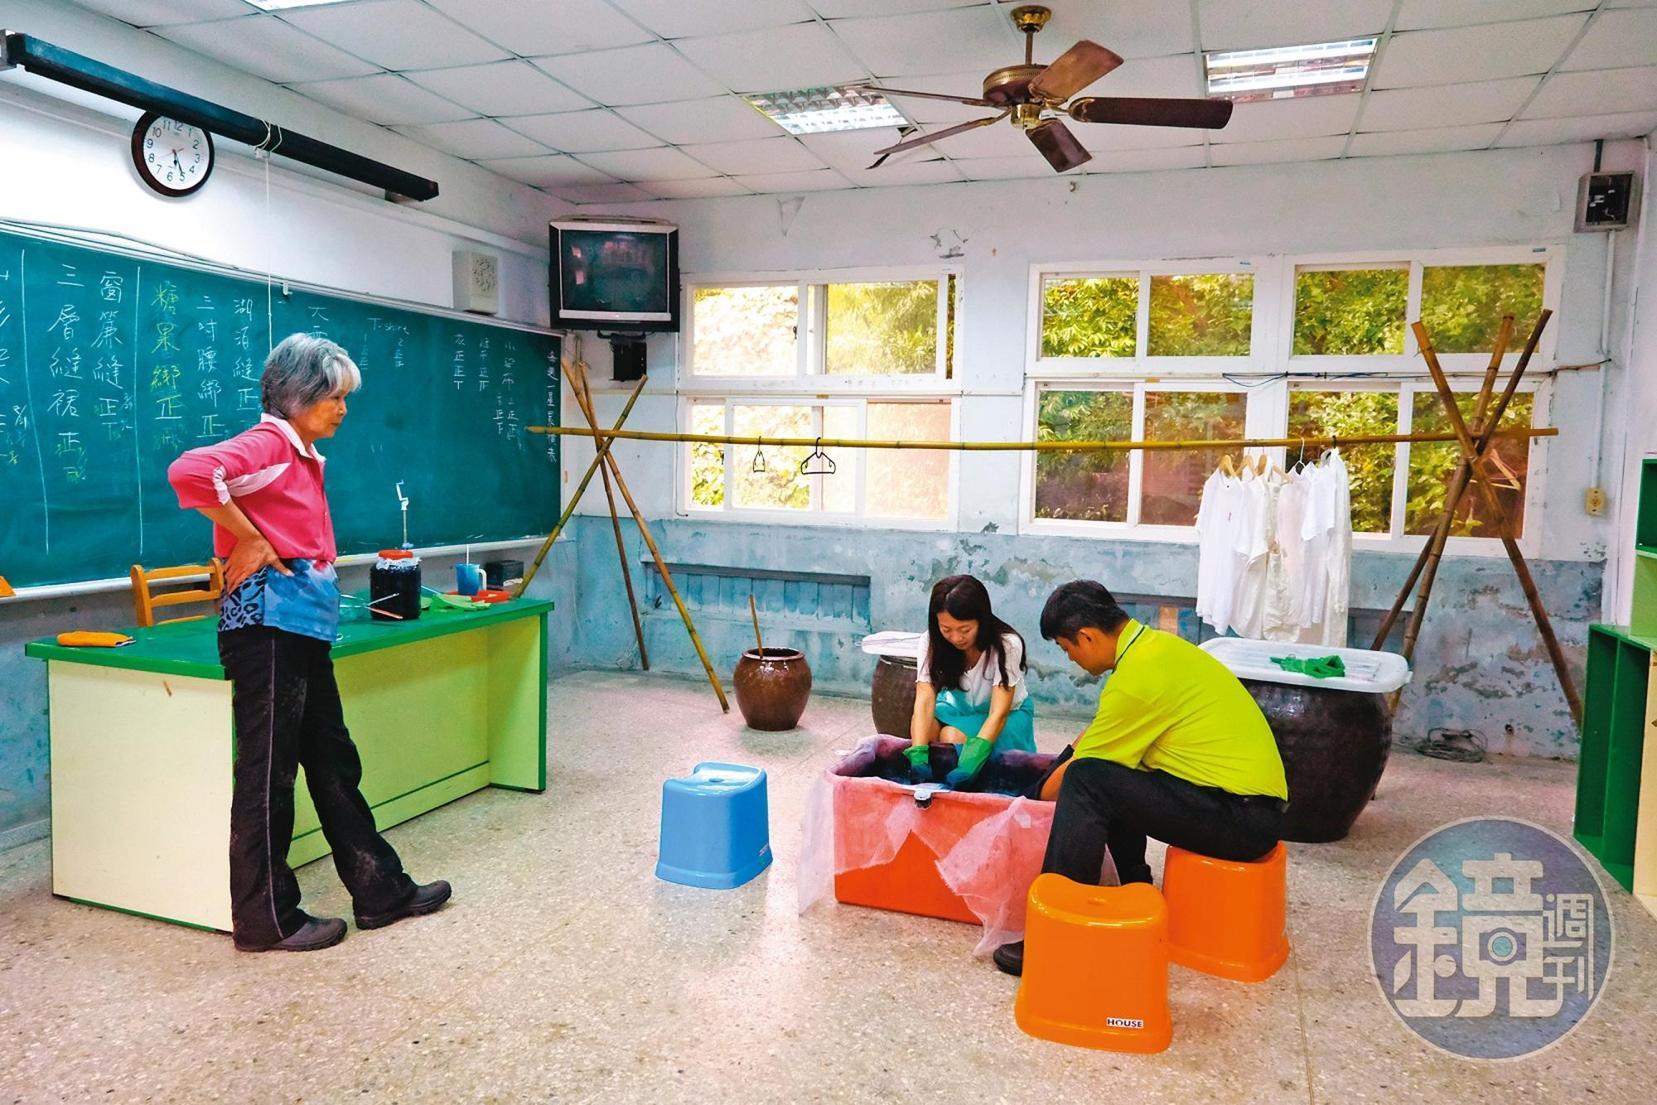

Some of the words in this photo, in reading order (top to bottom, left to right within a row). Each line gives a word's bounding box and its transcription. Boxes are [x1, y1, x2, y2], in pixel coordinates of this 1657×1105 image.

[163, 119, 171, 131] 11
[152, 127, 162, 138] 10
[146, 138, 154, 149] 9
[192, 139, 200, 150] 2
[147, 152, 155, 163] 8
[194, 153, 201, 163] 3
[156, 163, 162, 174] 7
[188, 165, 195, 174] 4
[166, 171, 173, 182] 6
[179, 171, 186, 182] 5
[1106, 1018, 1143, 1029] HOUSE
